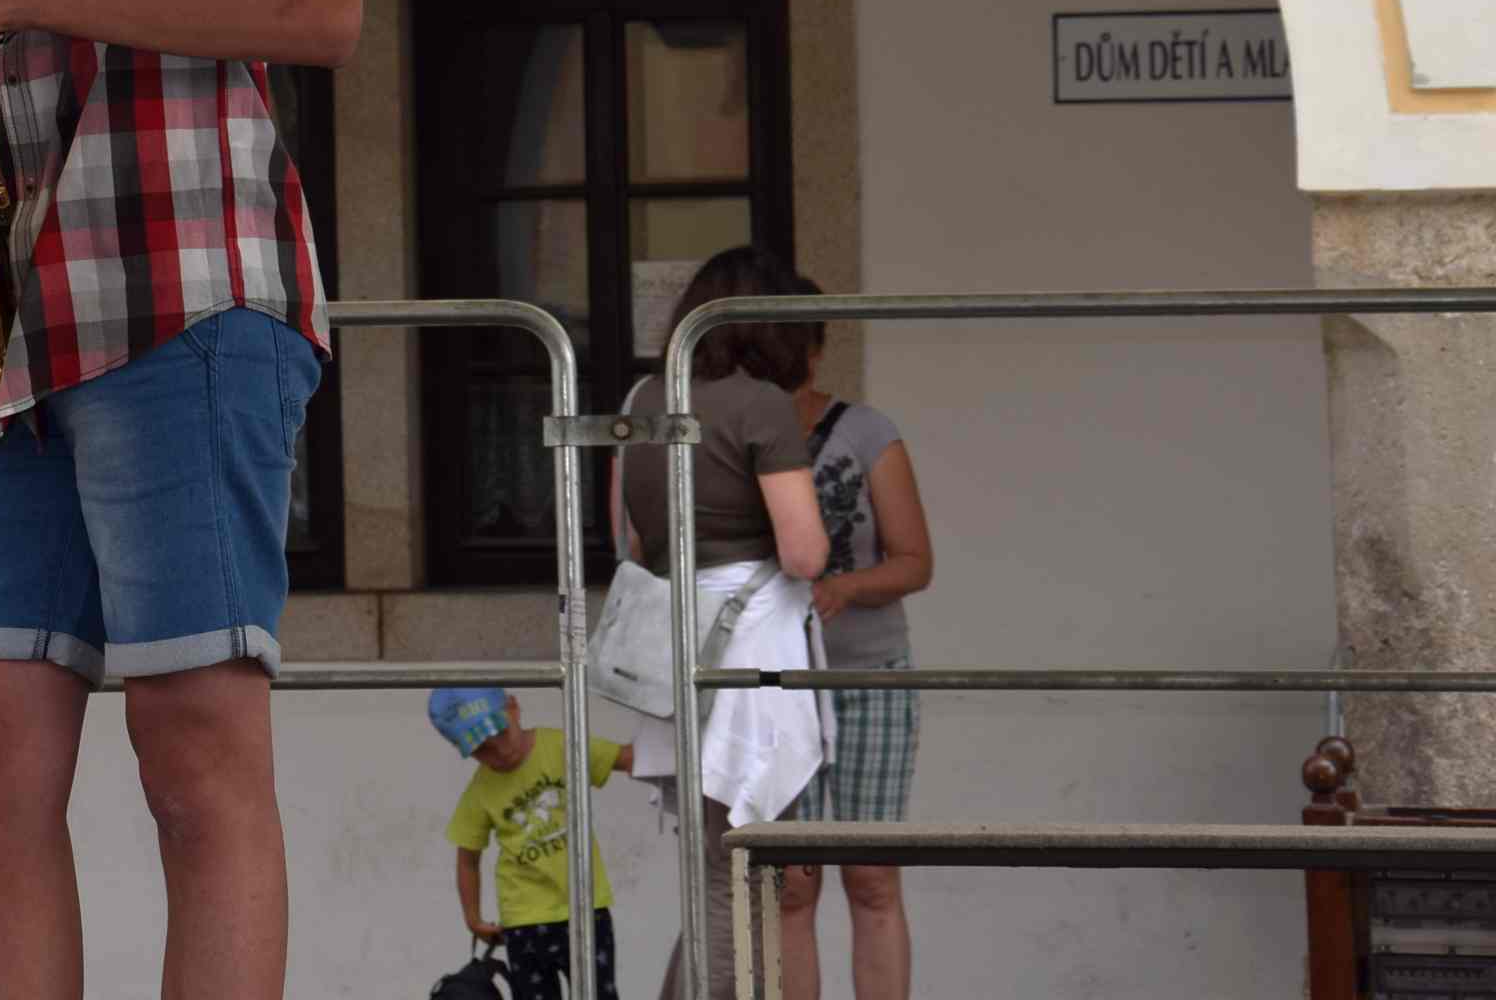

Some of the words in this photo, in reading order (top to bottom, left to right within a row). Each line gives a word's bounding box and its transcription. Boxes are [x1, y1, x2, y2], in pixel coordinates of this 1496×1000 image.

[1074, 32, 1141, 82] DŮM
[1149, 29, 1209, 80] DĚTÍ
[1215, 41, 1234, 79] A
